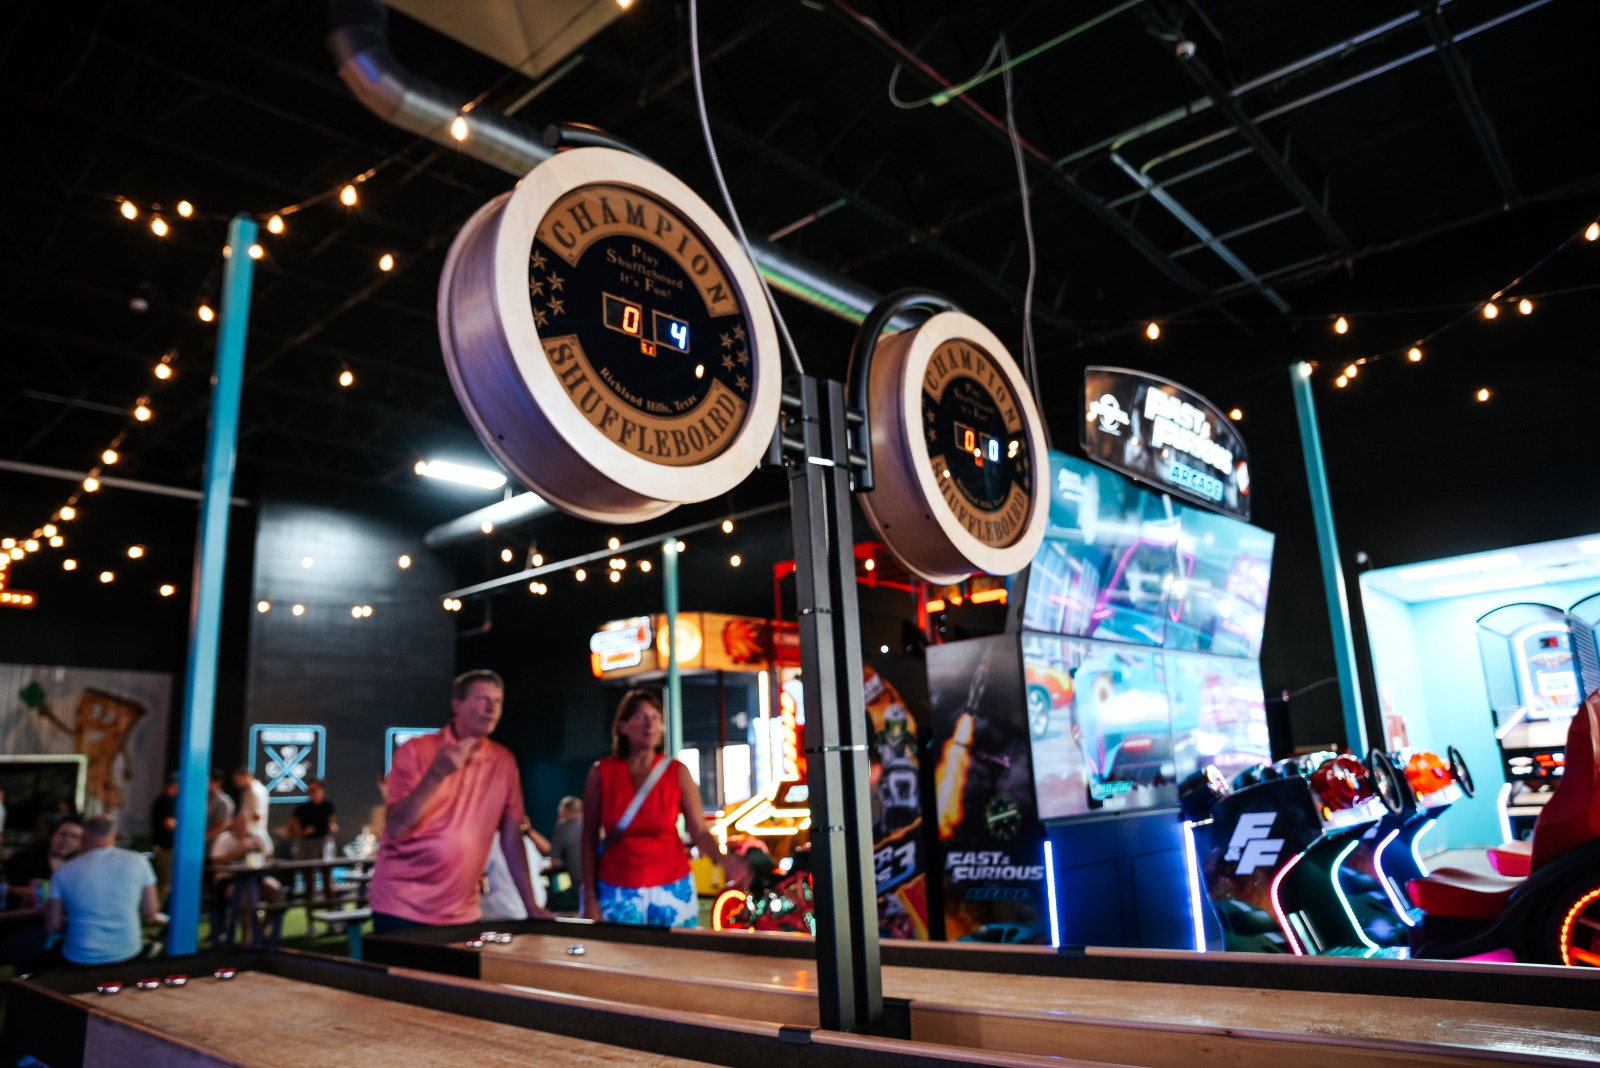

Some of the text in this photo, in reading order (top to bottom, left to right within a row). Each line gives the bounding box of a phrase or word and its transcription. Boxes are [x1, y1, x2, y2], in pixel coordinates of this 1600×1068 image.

[551, 197, 728, 303] CHAMPION
[606, 248, 683, 289] Shuffleboard
[623, 305, 640, 334] 0
[671, 322, 687, 350] 4
[548, 342, 737, 458] SHUFFLEBOARD
[600, 367, 642, 407] Richland
[925, 348, 1016, 424] CHAMPION
[964, 429, 975, 452] 0
[988, 439, 999, 462] 0
[933, 461, 1024, 541] SHUFFLEBOARD
[1168, 461, 1224, 501] ARCADE
[944, 851, 1003, 869] FAST
[951, 865, 1045, 883] FURIOUS
